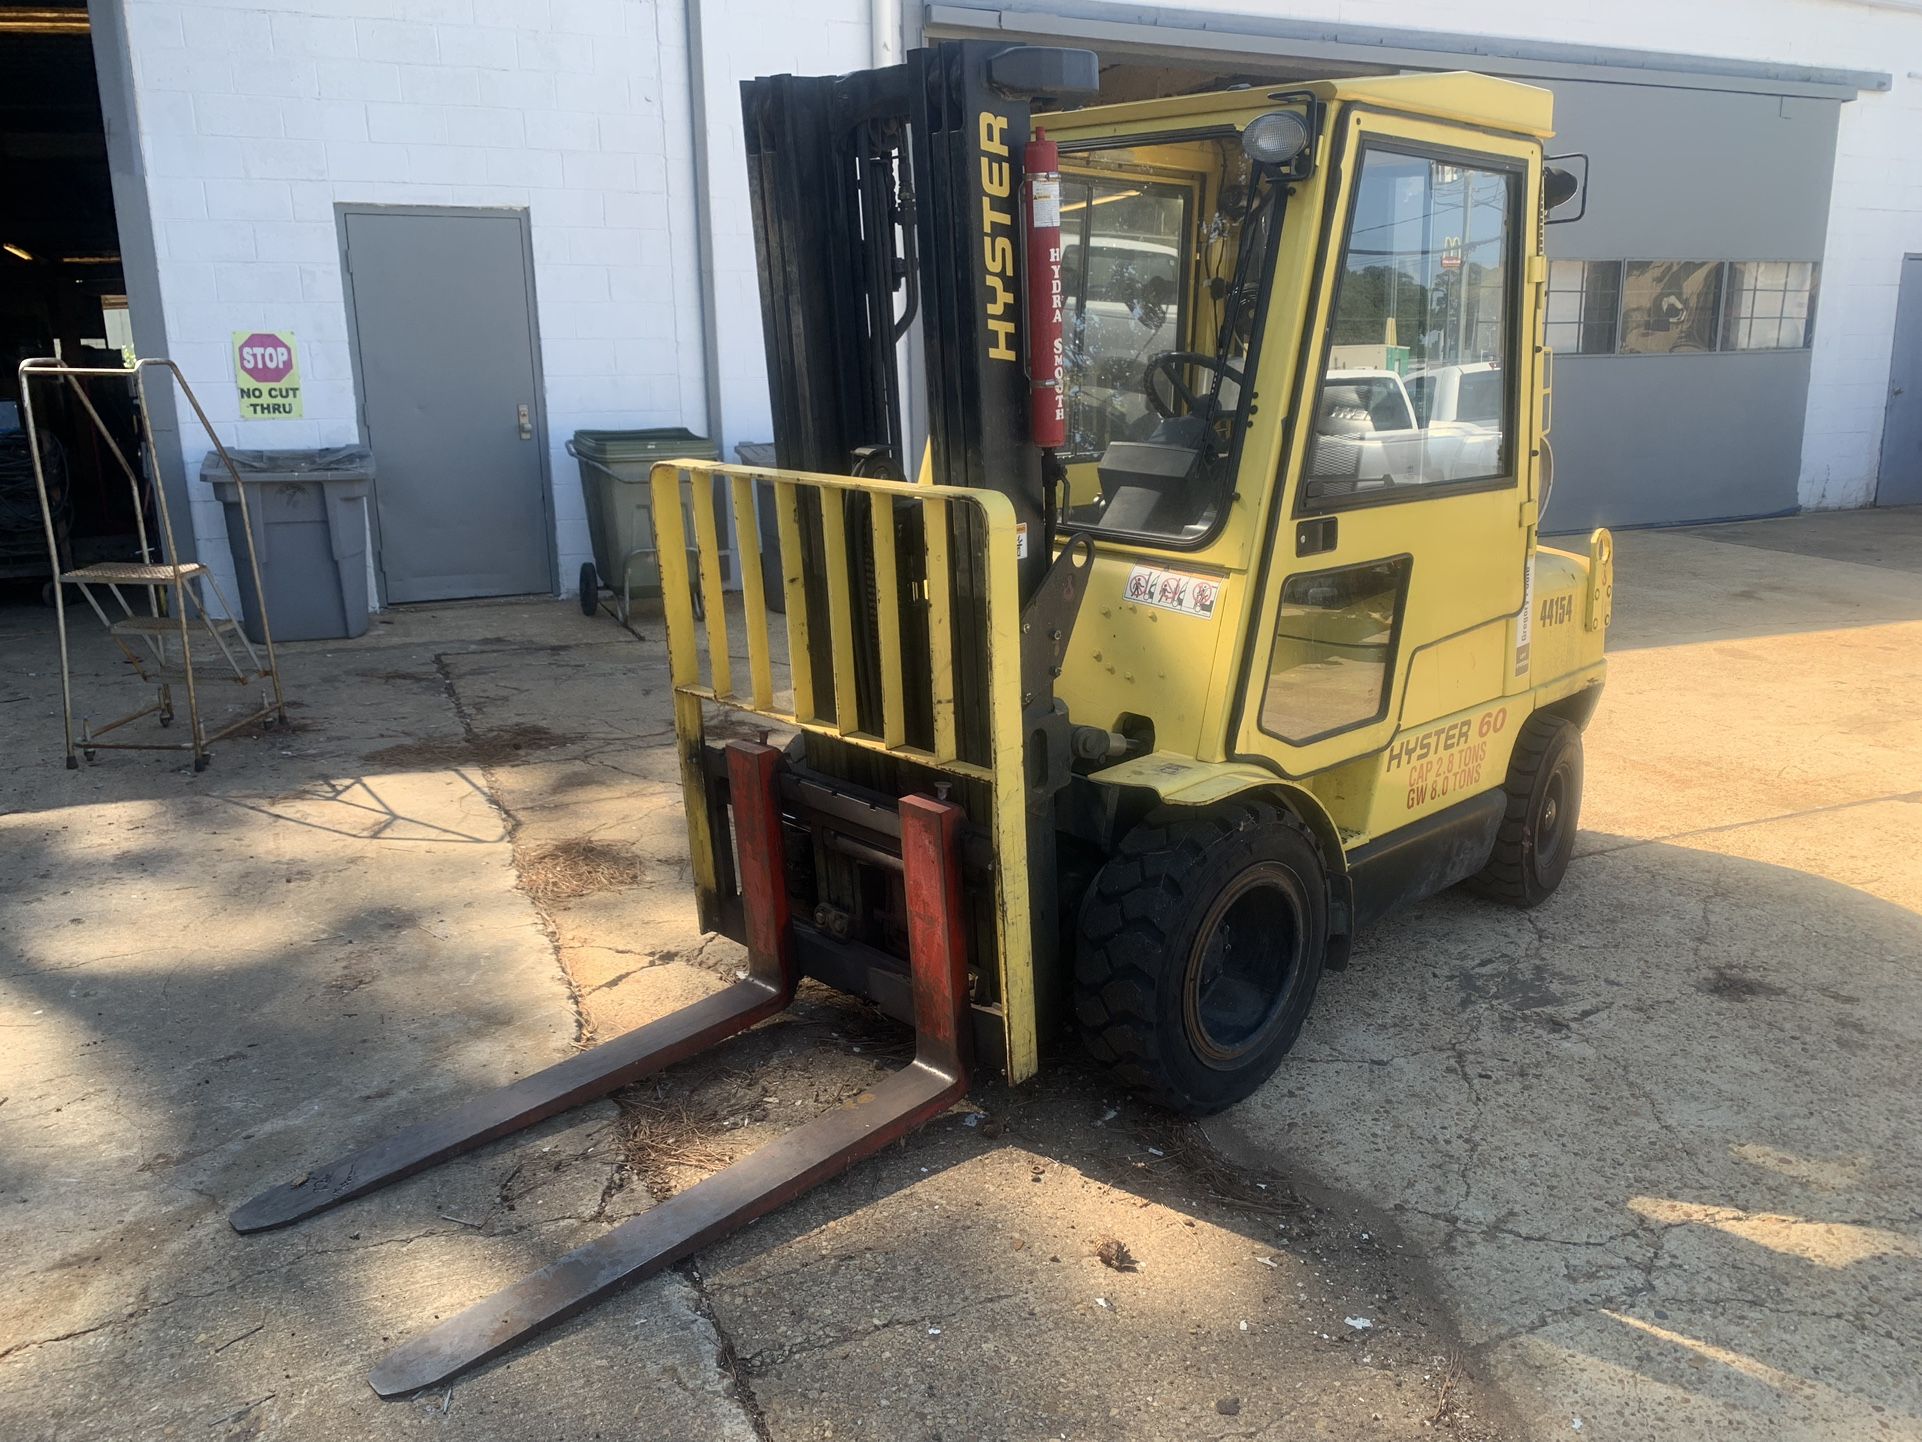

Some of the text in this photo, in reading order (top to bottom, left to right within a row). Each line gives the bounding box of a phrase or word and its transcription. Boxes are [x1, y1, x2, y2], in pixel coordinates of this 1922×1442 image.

[979, 111, 1016, 361] HYSTER
[242, 346, 289, 369] STOP
[1049, 248, 1065, 421] HYDRA SMOOTH
[239, 387, 300, 399] NO CUT
[249, 403, 293, 415] THRU
[1540, 595, 1573, 628] 44154
[1386, 707, 1508, 773] HYSTER 60
[1406, 763, 1482, 810] GW 8.0 TONS
[1408, 741, 1487, 788] CAP 2.8 TONS
